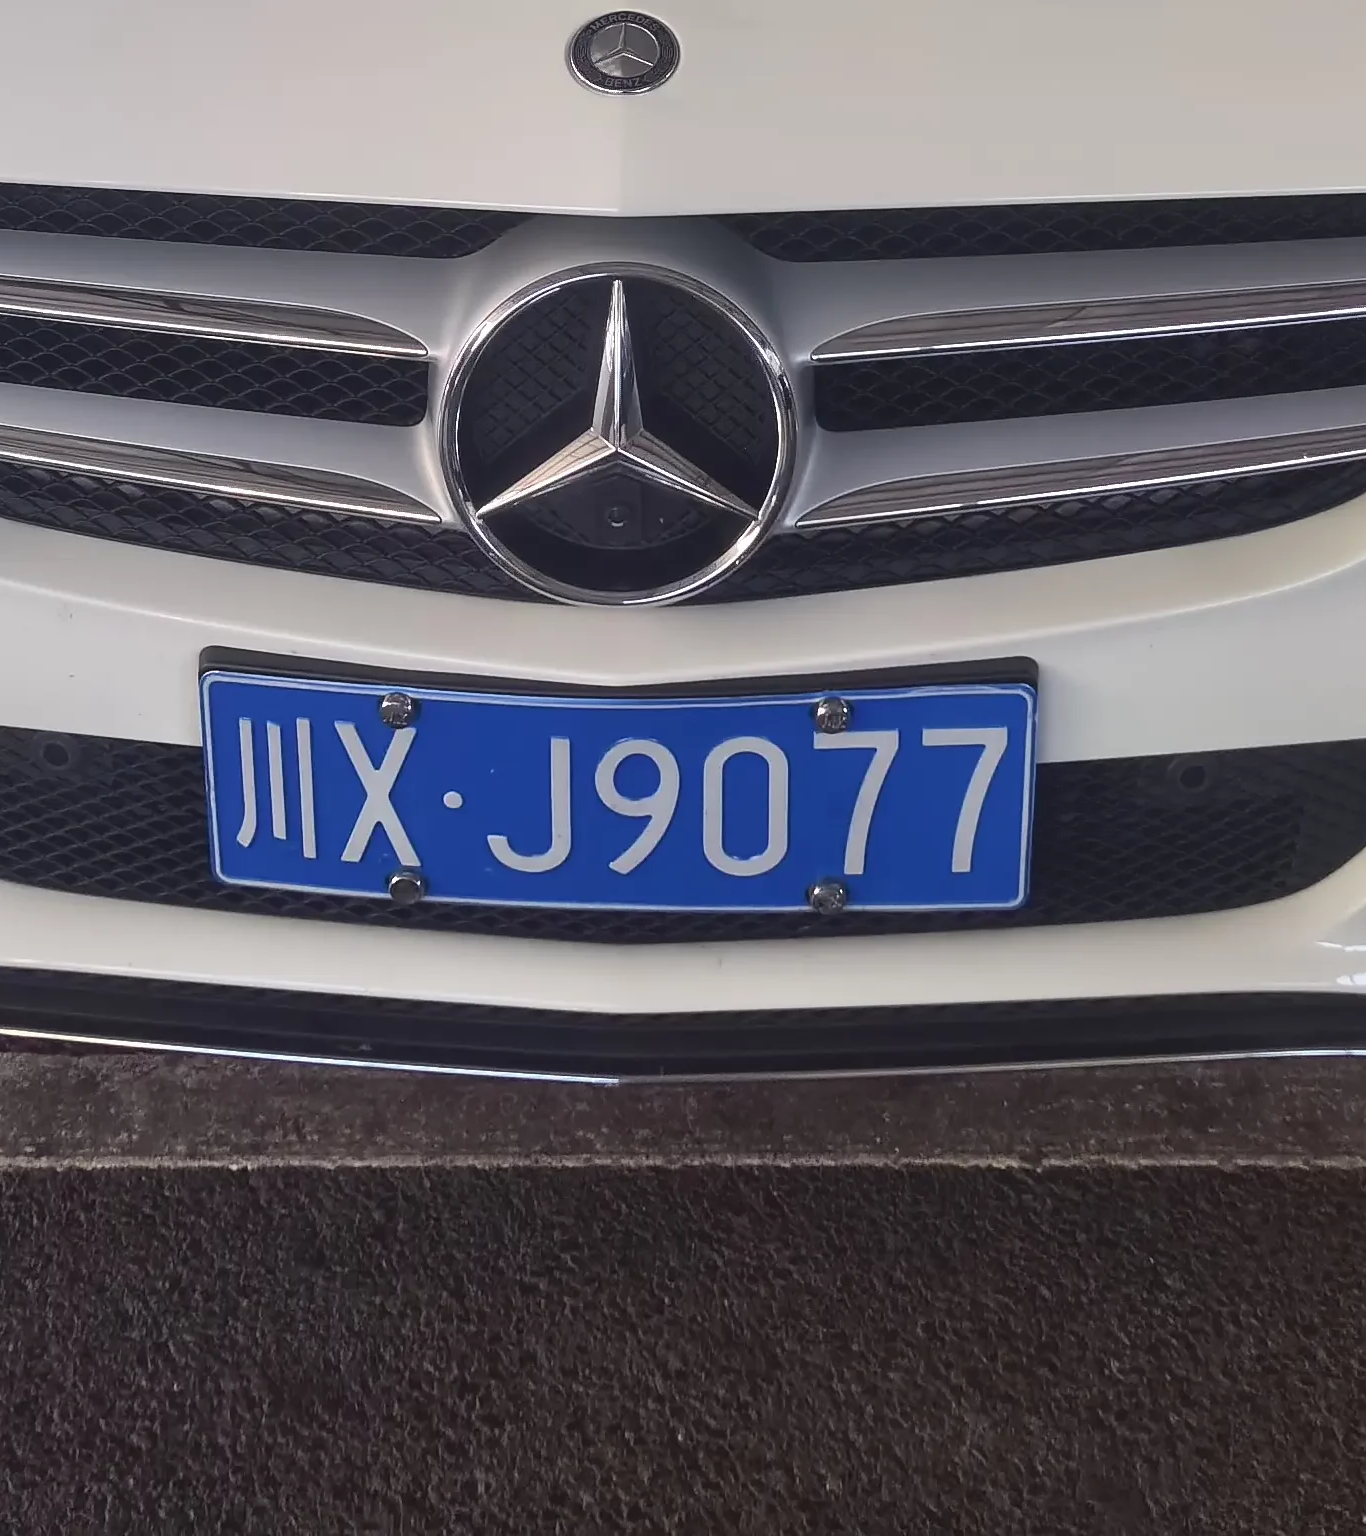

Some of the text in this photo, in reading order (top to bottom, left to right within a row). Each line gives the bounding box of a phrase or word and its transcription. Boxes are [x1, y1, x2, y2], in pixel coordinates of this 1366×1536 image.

[589, 12, 661, 32] MERCEDES
[604, 77, 641, 88] BENZ
[237, 717, 1009, 876] 川X·J9077
